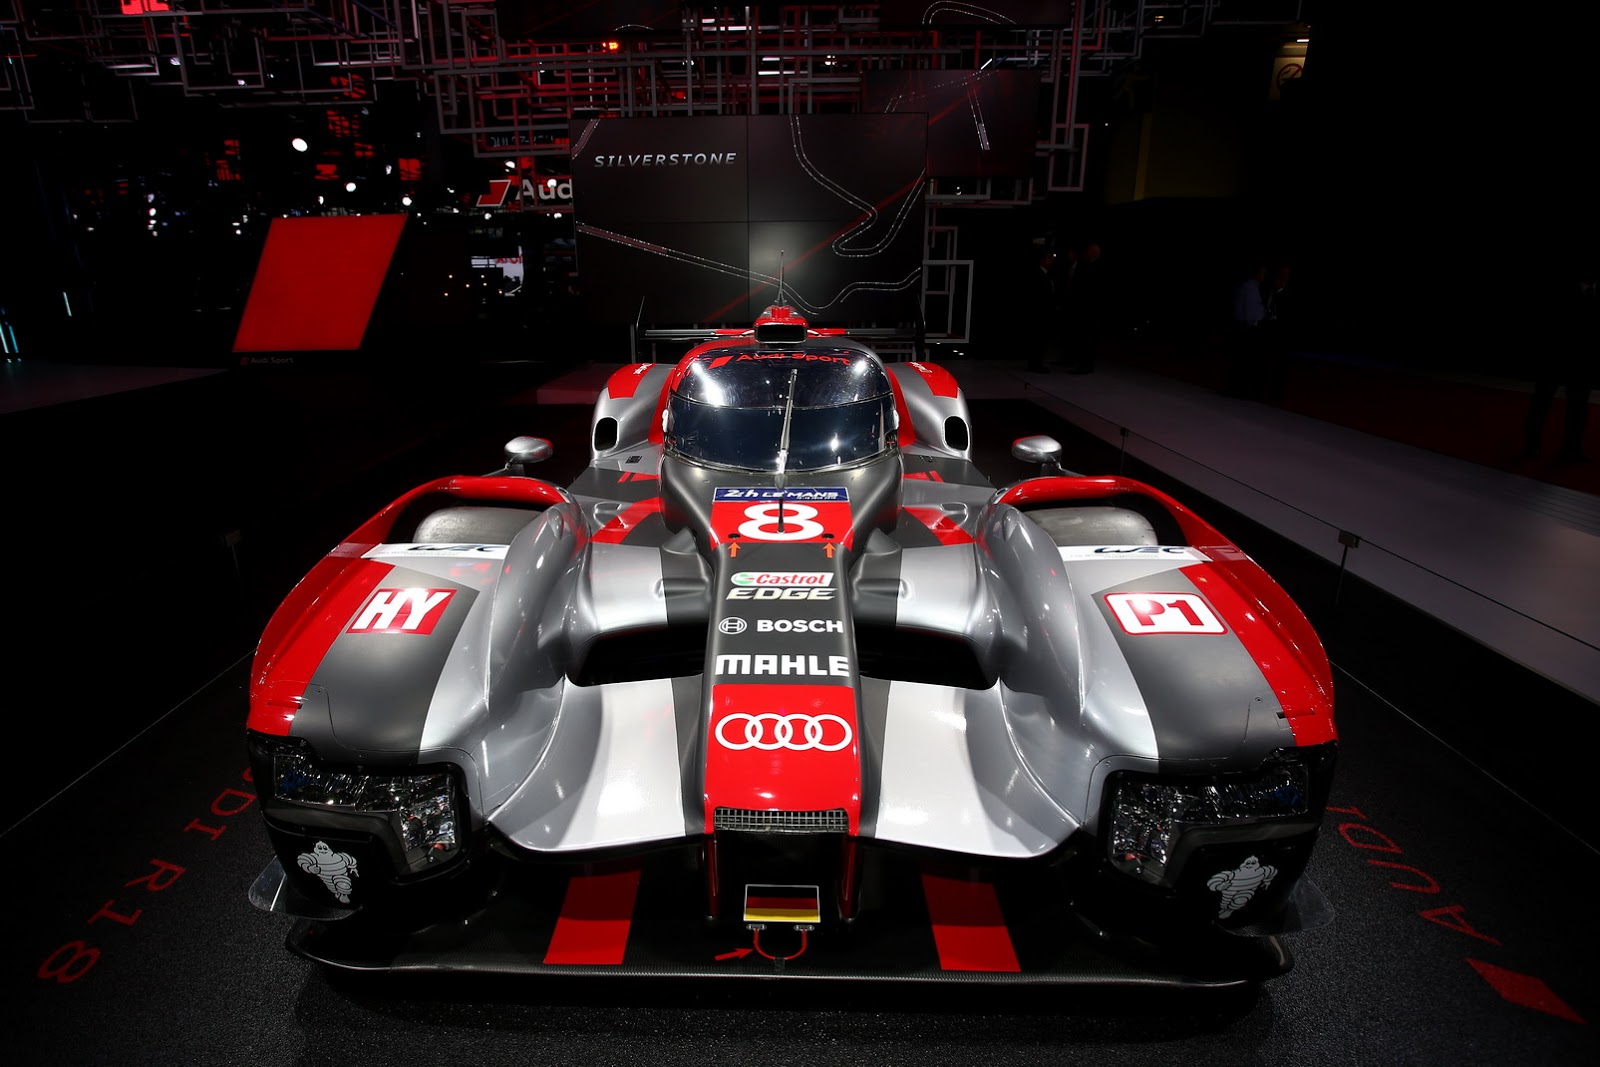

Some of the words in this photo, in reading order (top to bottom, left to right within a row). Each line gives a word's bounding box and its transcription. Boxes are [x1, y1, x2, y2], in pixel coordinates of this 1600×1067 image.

[594, 152, 737, 168] SILVERSTONE
[735, 353, 784, 362] Audi
[791, 352, 852, 367] Sport
[786, 489, 838, 498] MANS
[738, 502, 824, 541] 8
[756, 574, 826, 585] Castrol
[725, 587, 838, 601] EDGE
[351, 590, 452, 630] HY
[1124, 599, 1205, 626] P1
[756, 619, 845, 633] BOSCH
[715, 654, 850, 678] MAHLE
